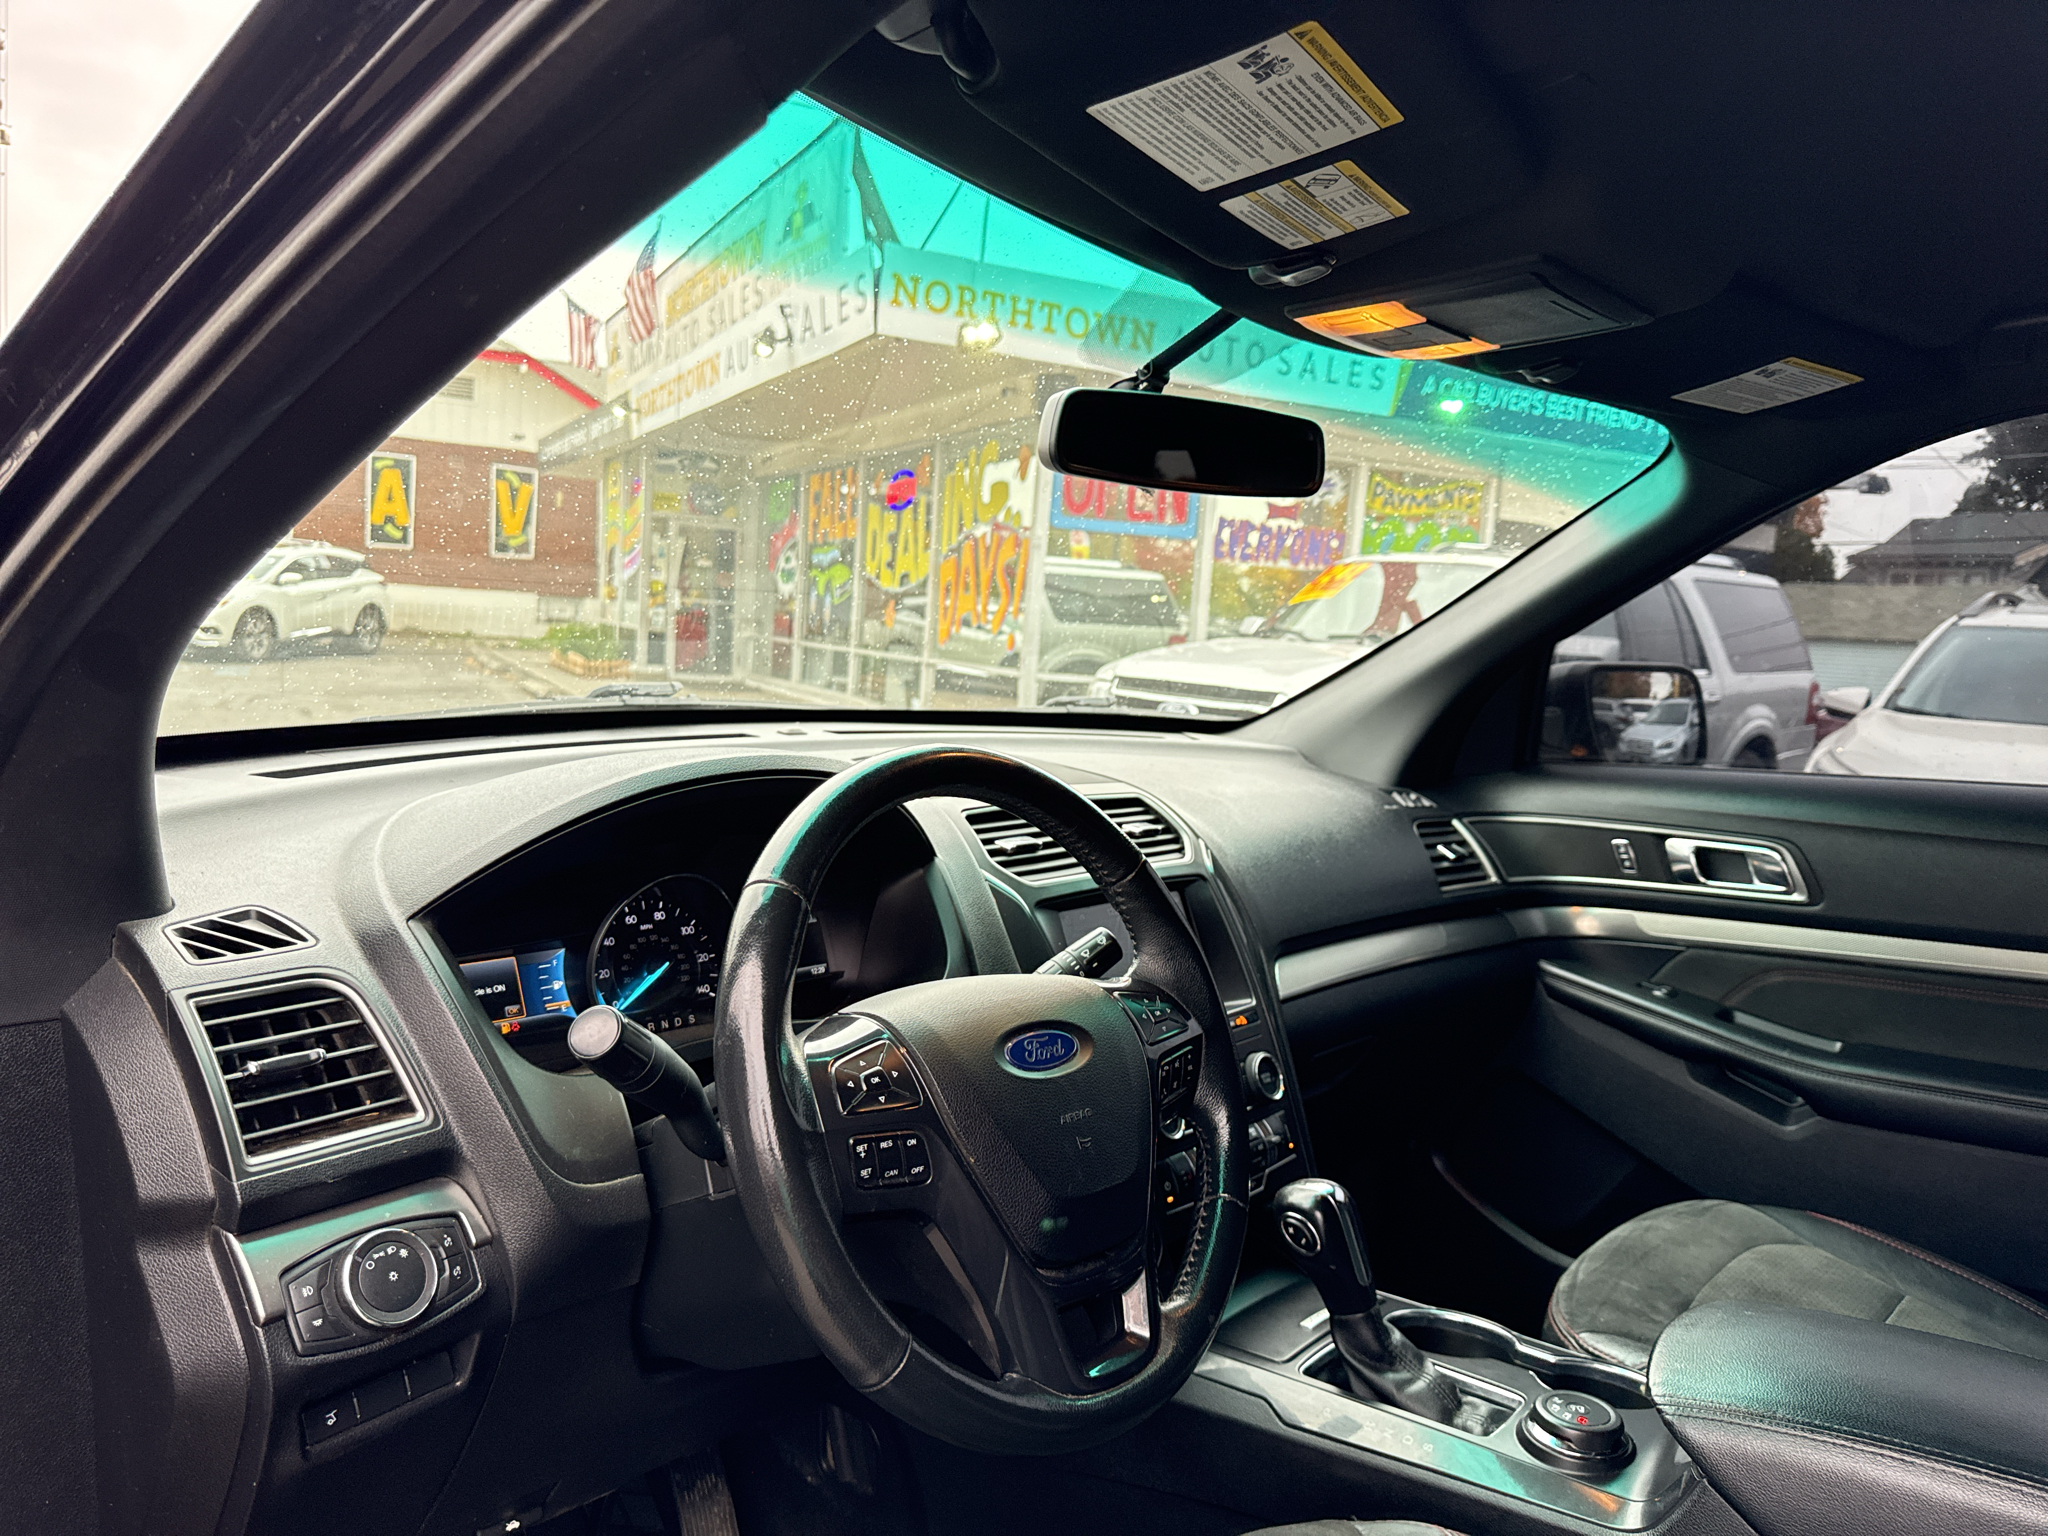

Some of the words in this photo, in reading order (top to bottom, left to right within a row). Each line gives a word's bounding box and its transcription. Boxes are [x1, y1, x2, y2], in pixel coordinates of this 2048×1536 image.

[1309, 71, 1326, 84] EVEN
[1319, 82, 1335, 93] WITH
[1346, 109, 1359, 117] AIR
[891, 273, 1156, 354] NORTHTOWN
[1276, 340, 1386, 392] SALES
[1545, 391, 1588, 422] BEST
[1372, 481, 1478, 510] PAYMENTS
[371, 467, 410, 528] A
[496, 478, 534, 538] V
[808, 466, 858, 544] FALL
[1214, 517, 1345, 567] EVERYONE
[938, 532, 1030, 652] DAYS!
[625, 914, 638, 925] 60
[653, 911, 666, 921] 80
[680, 925, 695, 936] 100
[604, 937, 615, 946] 40
[599, 969, 610, 978] 20
[493, 984, 506, 993] ON
[508, 1005, 520, 1015] OK
[647, 1022, 655, 1032] R
[661, 1019, 669, 1029] N
[674, 1017, 682, 1027] D
[688, 1014, 696, 1024] S
[1023, 1035, 1065, 1063] Ford
[870, 1076, 881, 1084] OK
[856, 1143, 868, 1153] SET
[880, 1139, 893, 1150] RES
[907, 1138, 917, 1147] ON
[860, 1167, 873, 1177] SET
[884, 1168, 899, 1178] CAN
[911, 1165, 925, 1175] OFF
